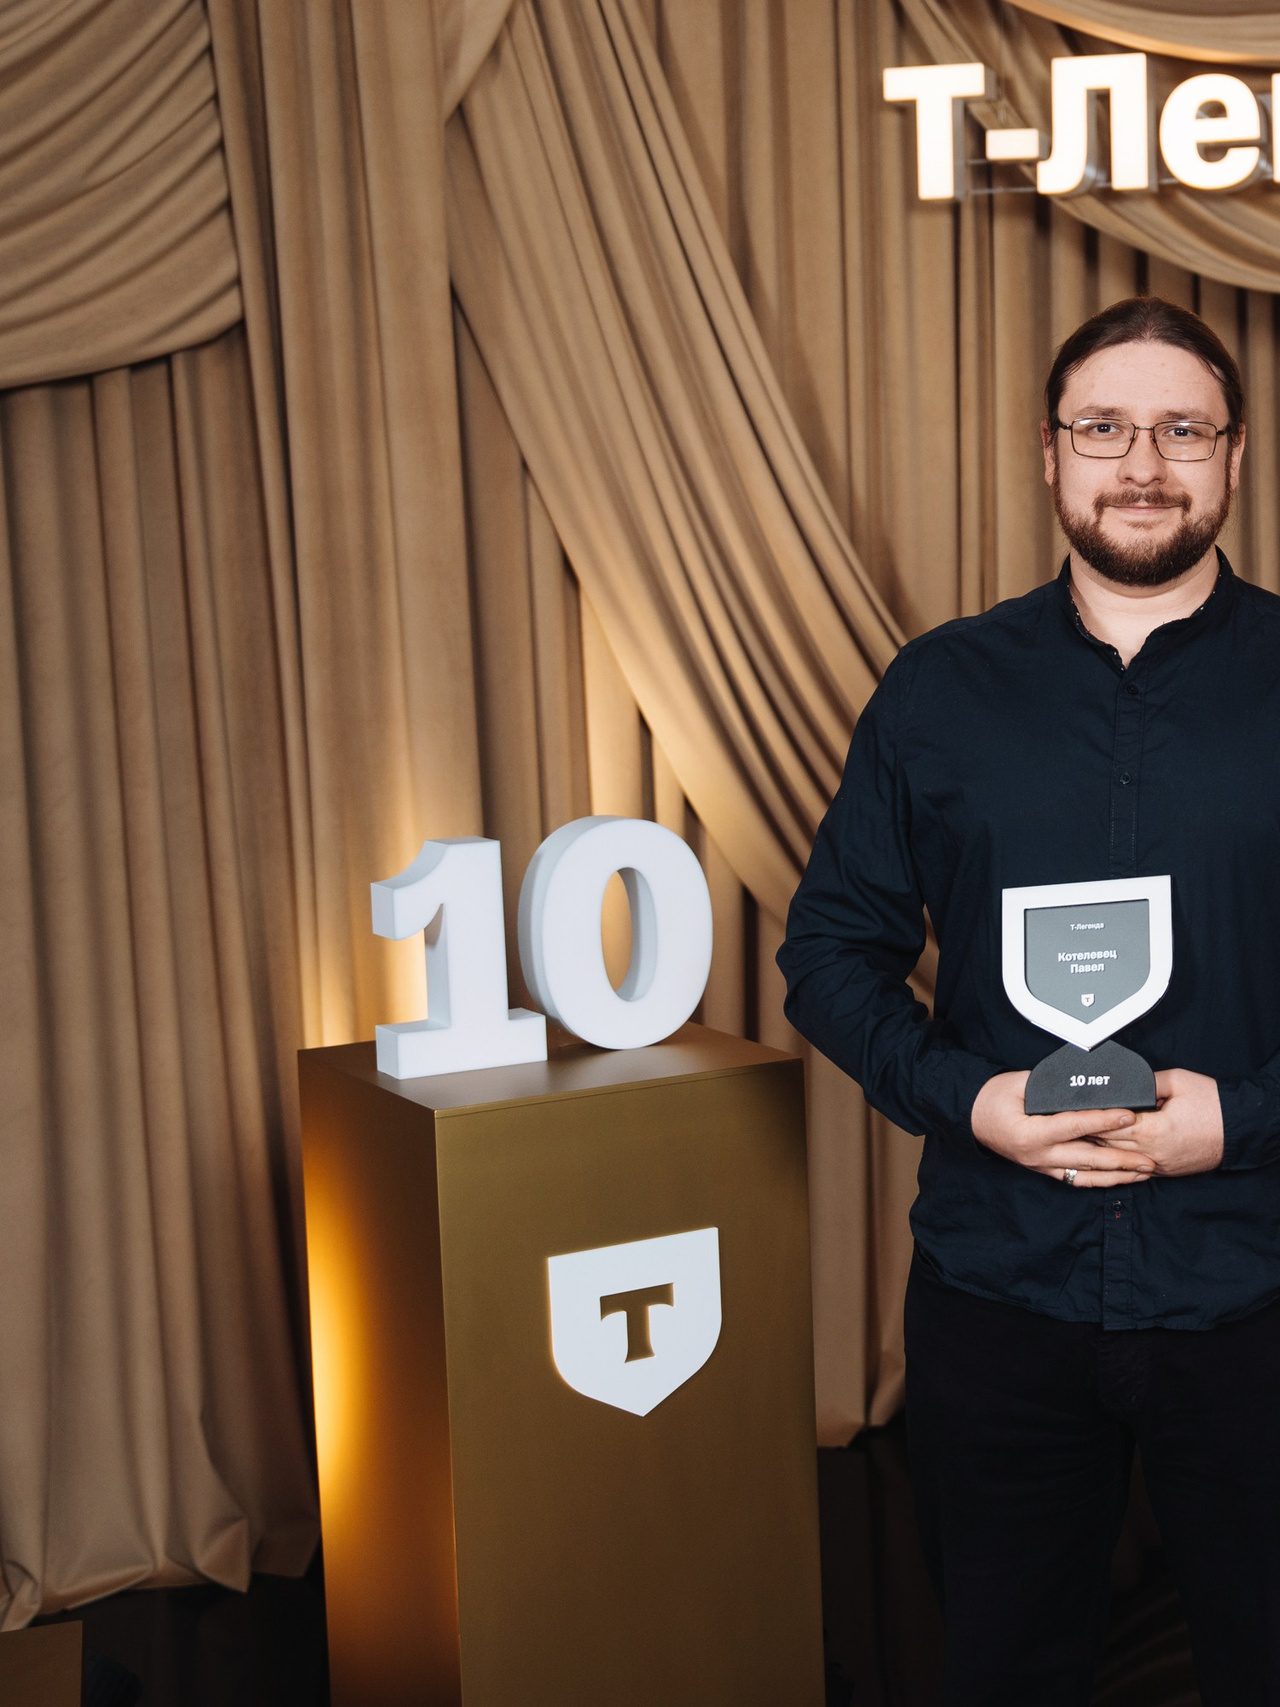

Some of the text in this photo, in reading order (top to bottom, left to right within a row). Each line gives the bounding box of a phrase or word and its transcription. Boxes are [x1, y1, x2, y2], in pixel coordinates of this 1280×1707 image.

[371, 815, 714, 1080] 10
[1058, 950, 1118, 962] Котелевец
[1070, 963, 1105, 974] Павел
[1070, 1074, 1111, 1087] 10 лет
